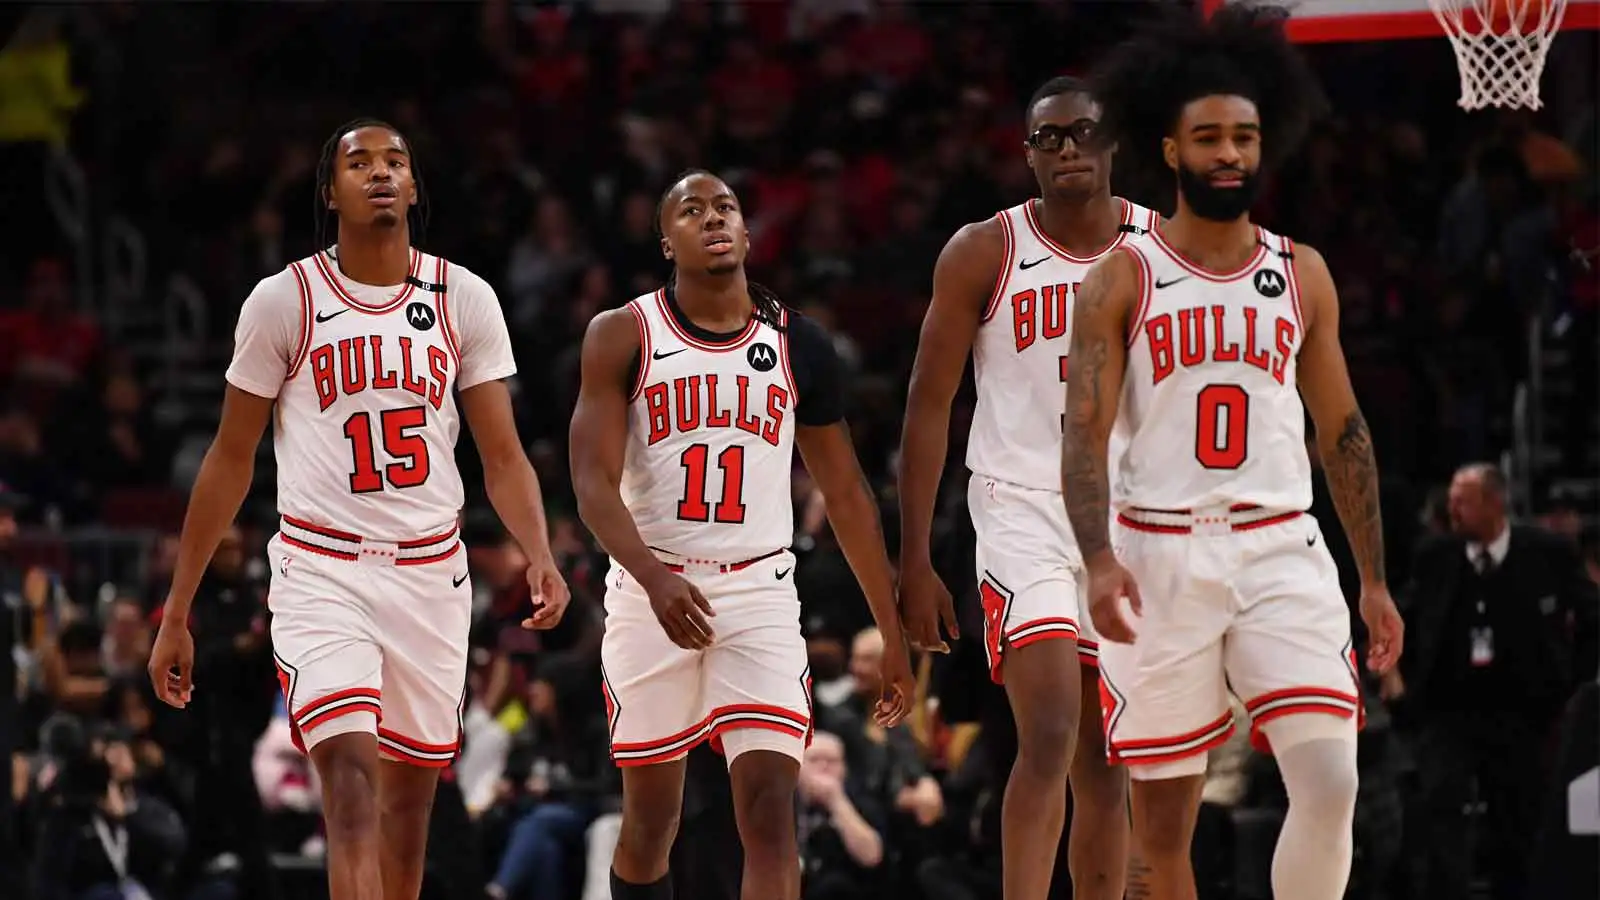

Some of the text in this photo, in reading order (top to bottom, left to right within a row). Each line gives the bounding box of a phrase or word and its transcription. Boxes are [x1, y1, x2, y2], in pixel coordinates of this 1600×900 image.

[1012, 281, 1081, 353] BU
[1146, 305, 1295, 386] BULLS
[310, 335, 448, 413] BULLS
[644, 374, 788, 447] BULLS
[343, 407, 429, 493] 15
[1195, 384, 1248, 469] 0
[677, 443, 746, 524] 11
